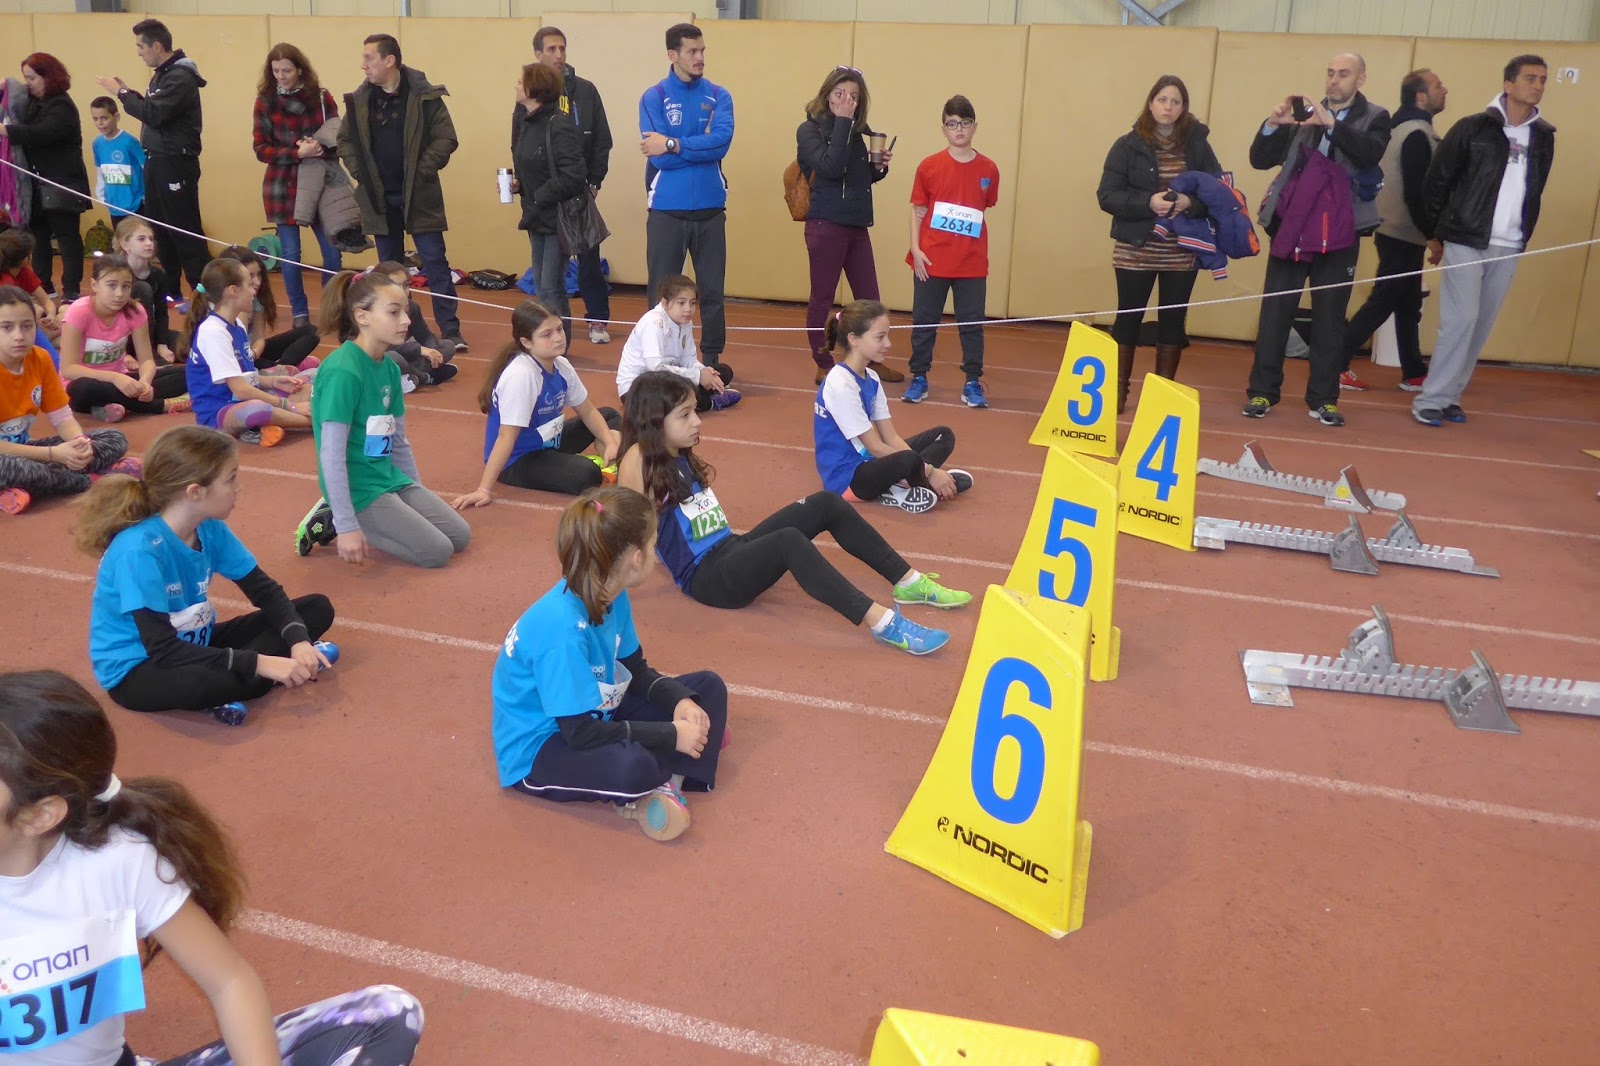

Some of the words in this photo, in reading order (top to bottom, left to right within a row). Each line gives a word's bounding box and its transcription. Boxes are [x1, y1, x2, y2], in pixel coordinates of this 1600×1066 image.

[940, 216, 973, 234] 2634
[1067, 355, 1107, 427] 3
[1060, 429, 1107, 443] NORDIC
[1135, 414, 1182, 502] 4
[1127, 504, 1180, 526] NORDIC
[1038, 497, 1098, 608] 5
[971, 657, 1053, 825] 6
[953, 823, 1049, 884] NORDIC
